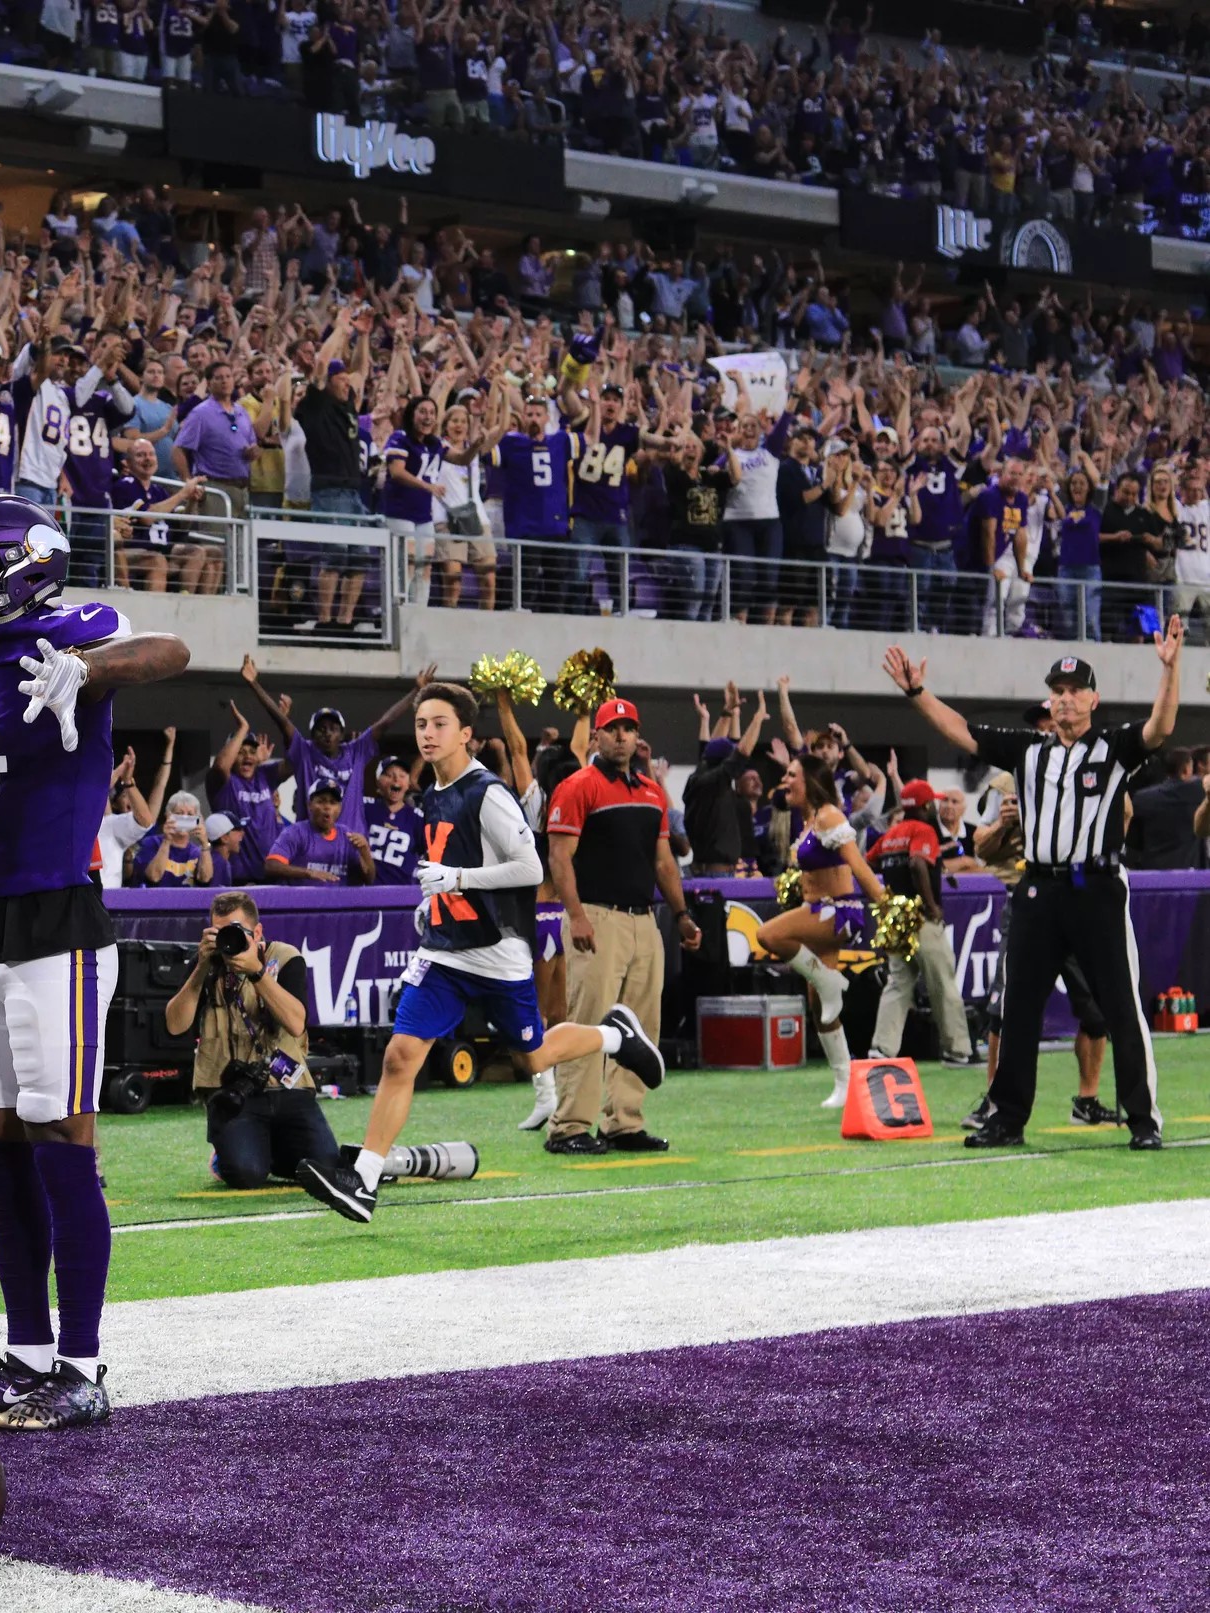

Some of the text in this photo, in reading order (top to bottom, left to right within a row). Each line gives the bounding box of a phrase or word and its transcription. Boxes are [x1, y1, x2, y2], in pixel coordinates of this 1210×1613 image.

[70, 415, 109, 458] 84
[531, 451, 552, 487] 5
[578, 442, 625, 487] 84
[368, 824, 411, 867] 22
[866, 1064, 923, 1128] G
